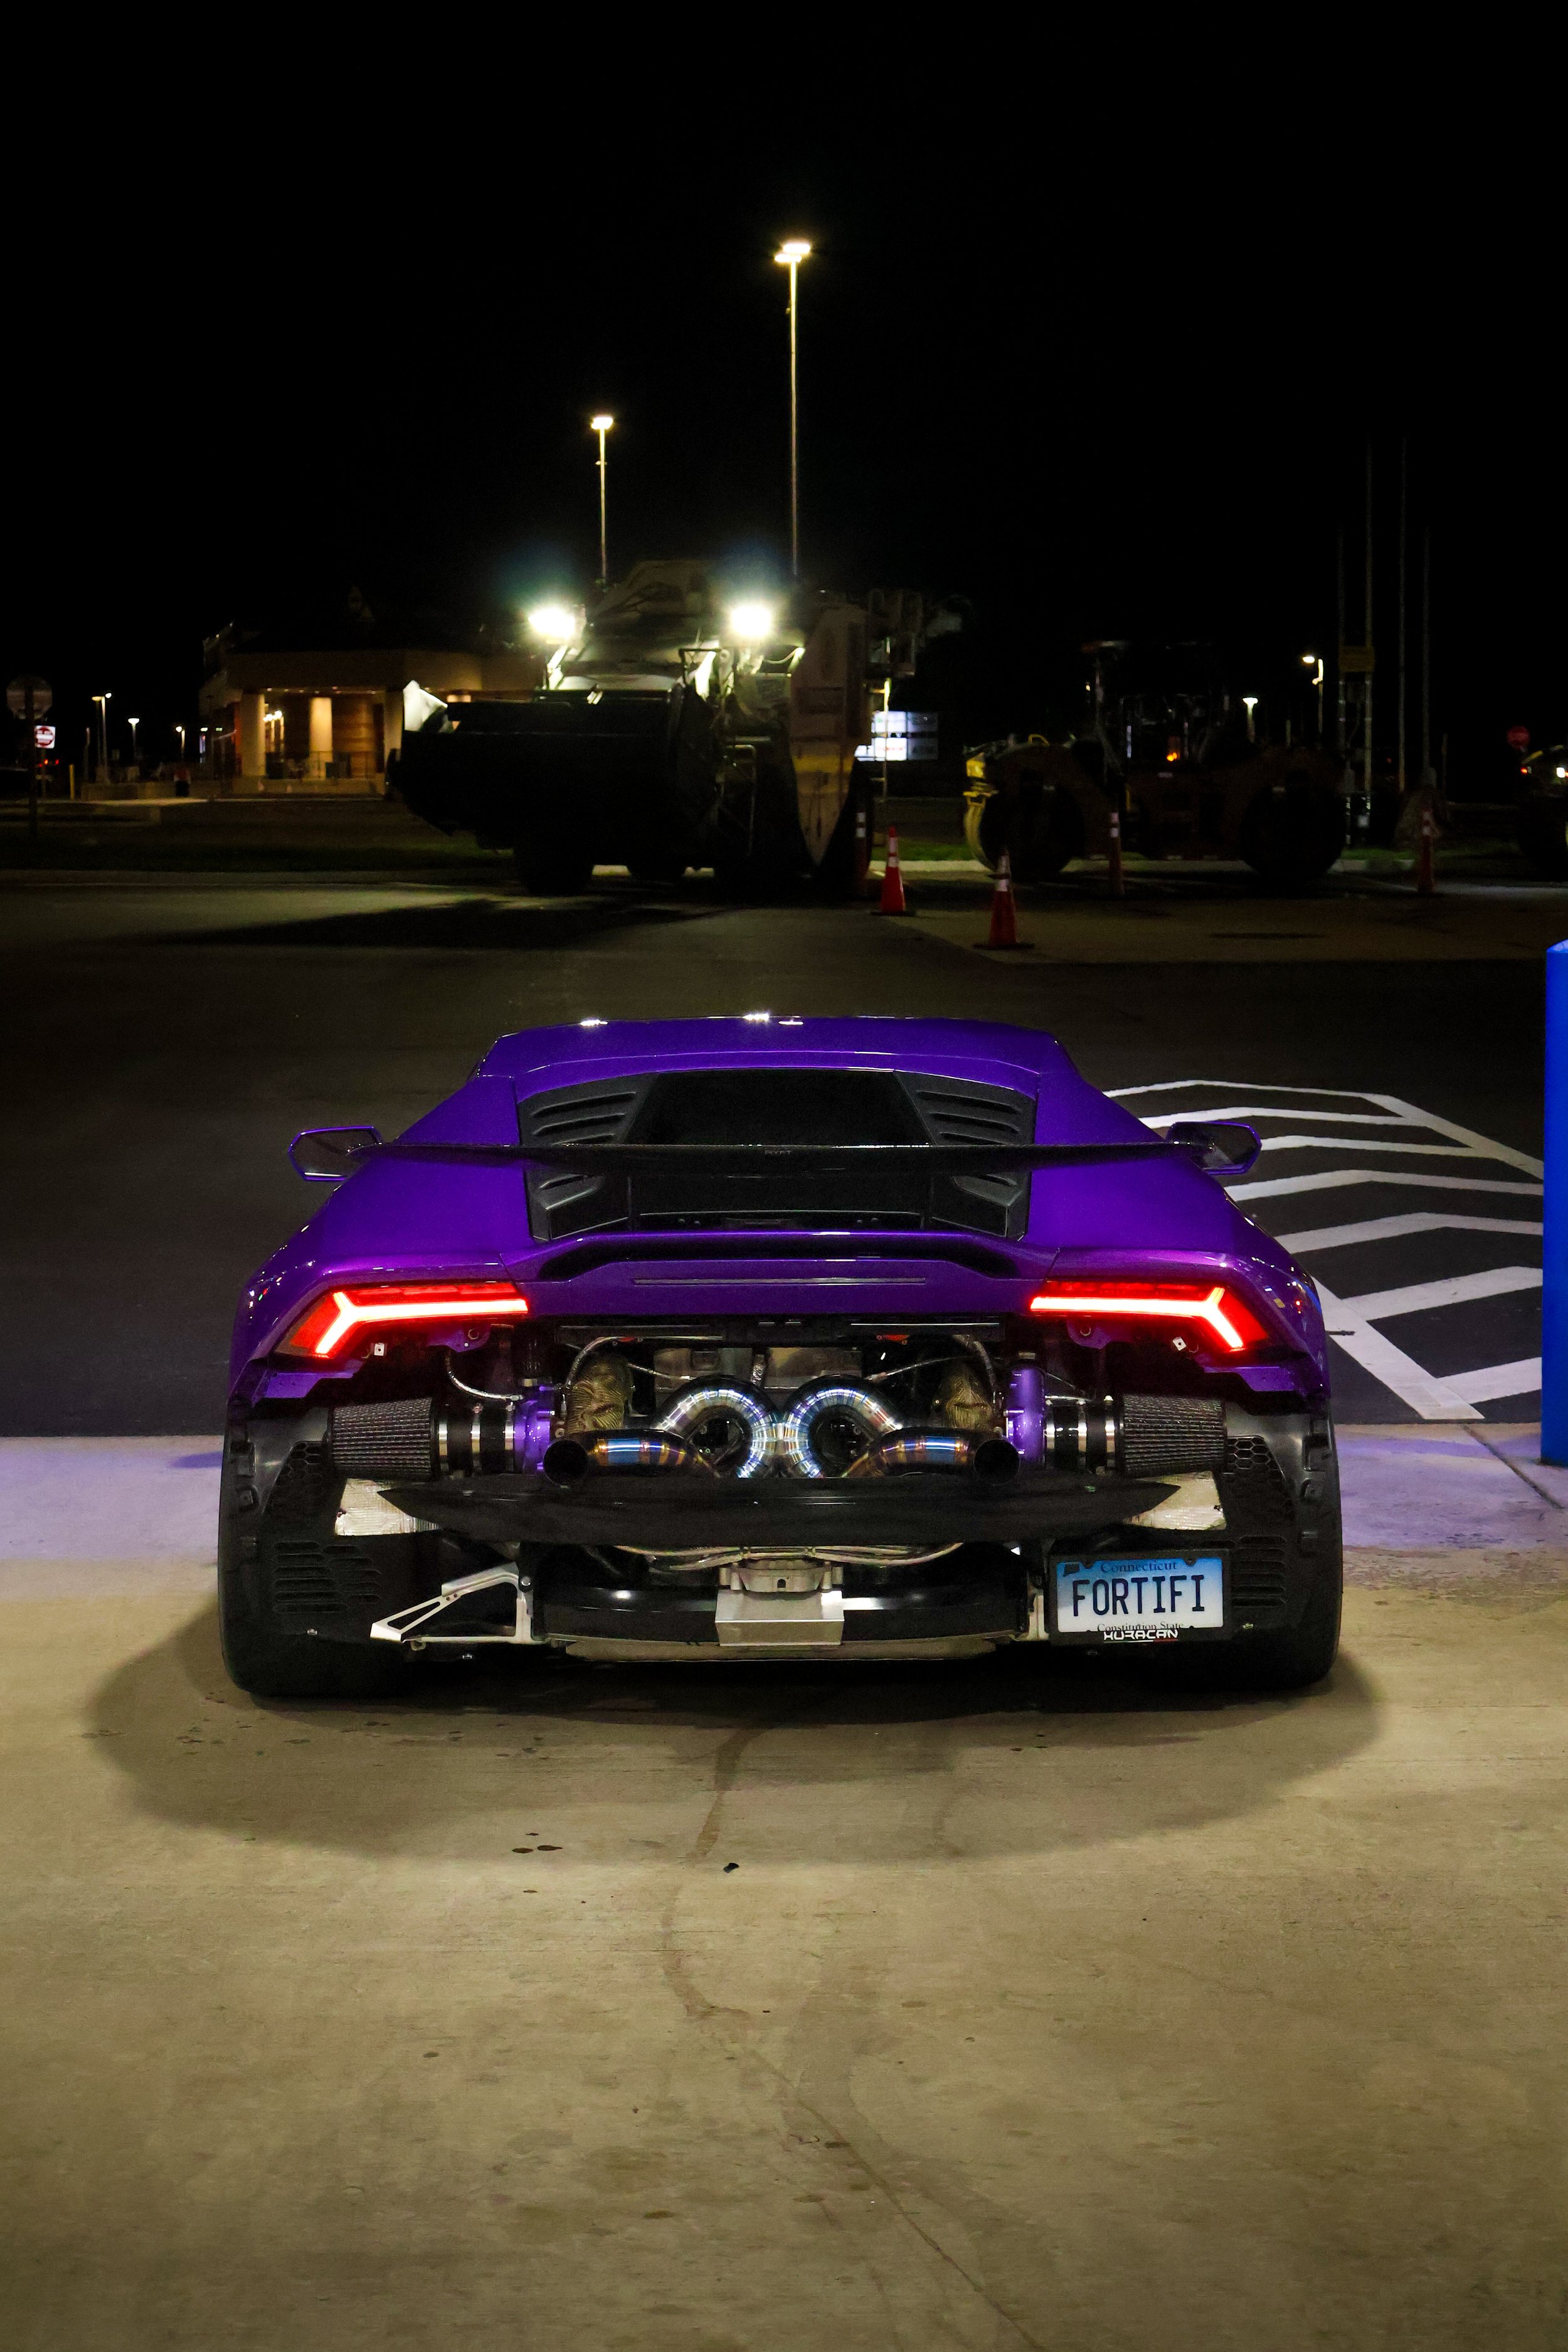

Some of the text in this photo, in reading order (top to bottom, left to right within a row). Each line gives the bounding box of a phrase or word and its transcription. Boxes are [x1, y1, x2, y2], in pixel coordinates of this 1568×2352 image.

[1101, 1560, 1177, 1572] Connecticut
[1073, 1575, 1205, 1616] FORTIFI
[1098, 1621, 1184, 1632] Constitution State
[1103, 1629, 1179, 1641] HURACAN
